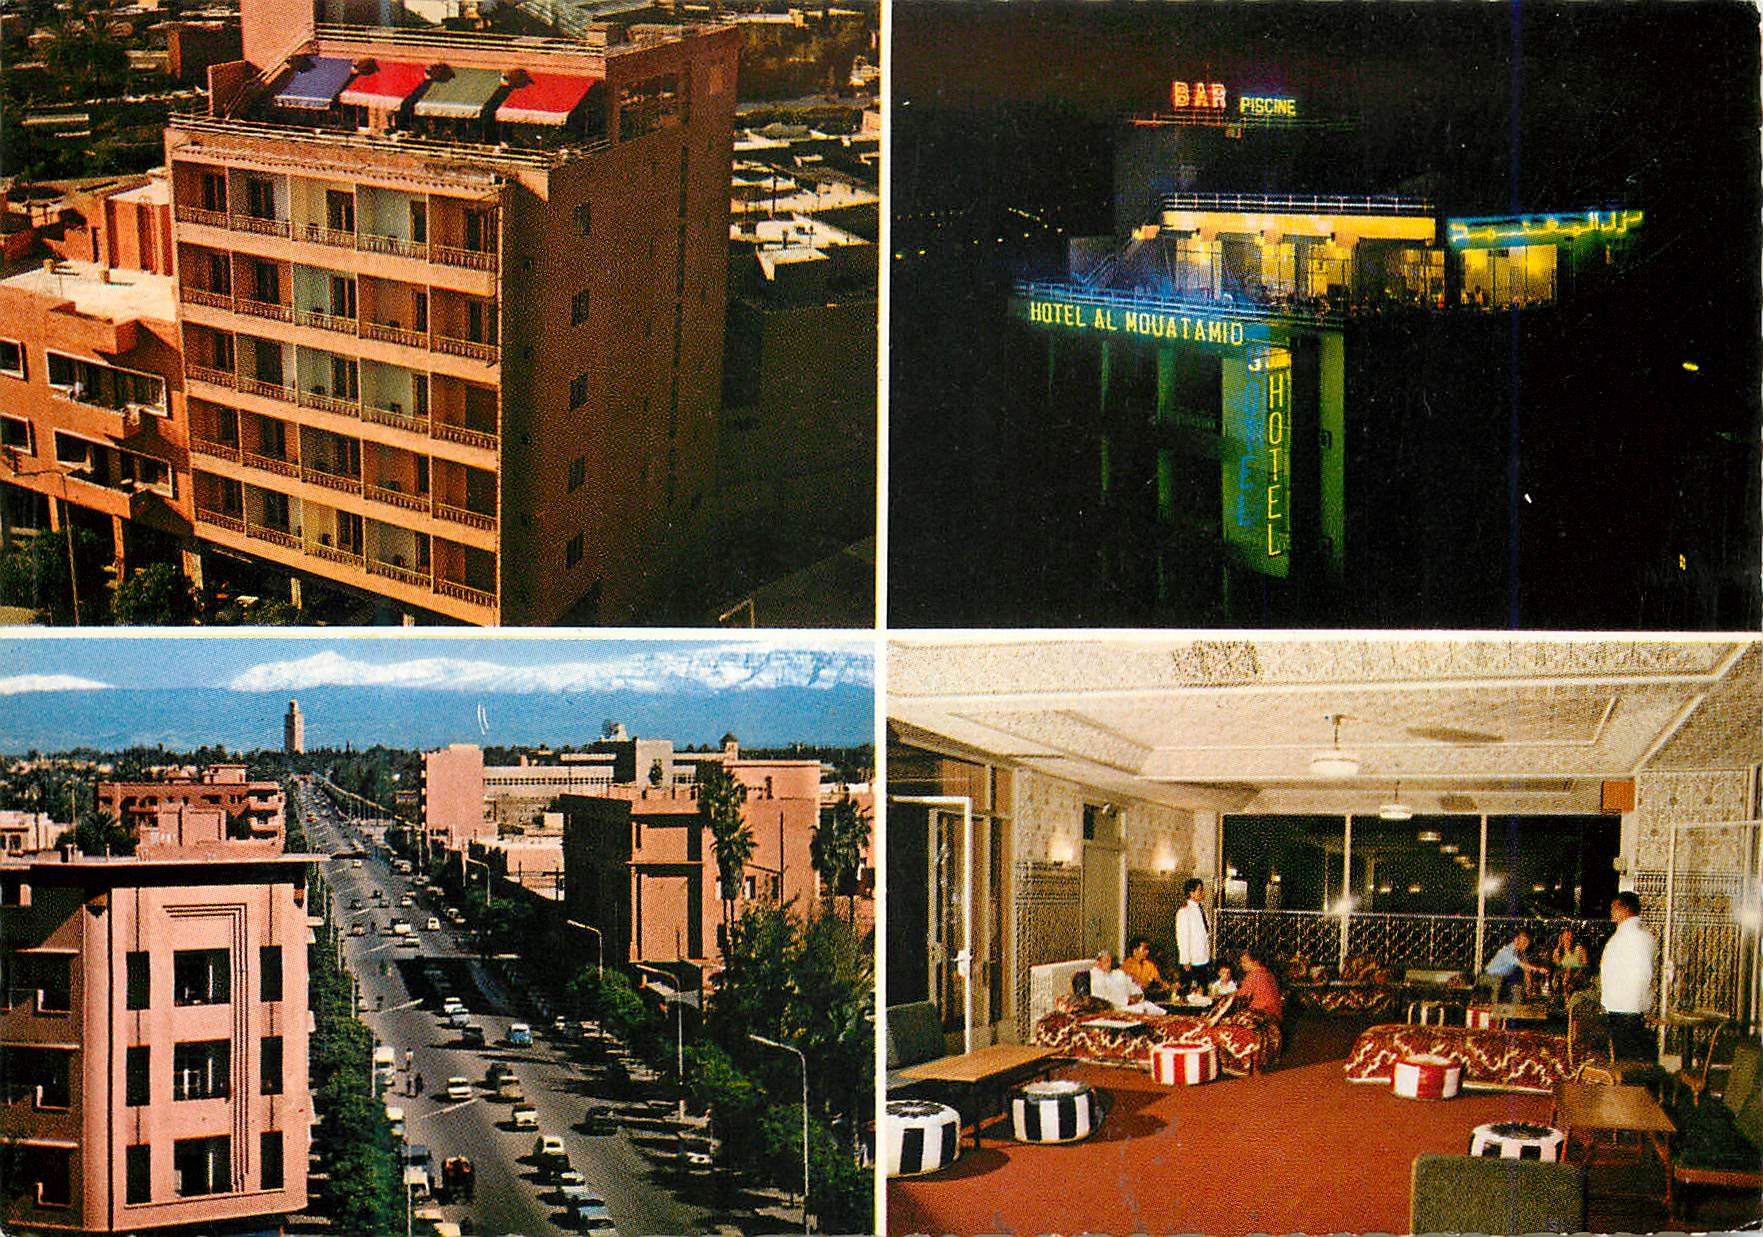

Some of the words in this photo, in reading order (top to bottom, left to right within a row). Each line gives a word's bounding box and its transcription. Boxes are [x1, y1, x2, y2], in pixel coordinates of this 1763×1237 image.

[1173, 81, 1226, 109] BAR
[1239, 97, 1297, 117] PISCINE
[1030, 301, 1086, 328] HOTEL
[1094, 308, 1118, 331] AL
[1125, 311, 1243, 346] MOUATAMID
[1267, 373, 1284, 556] HOTEL
